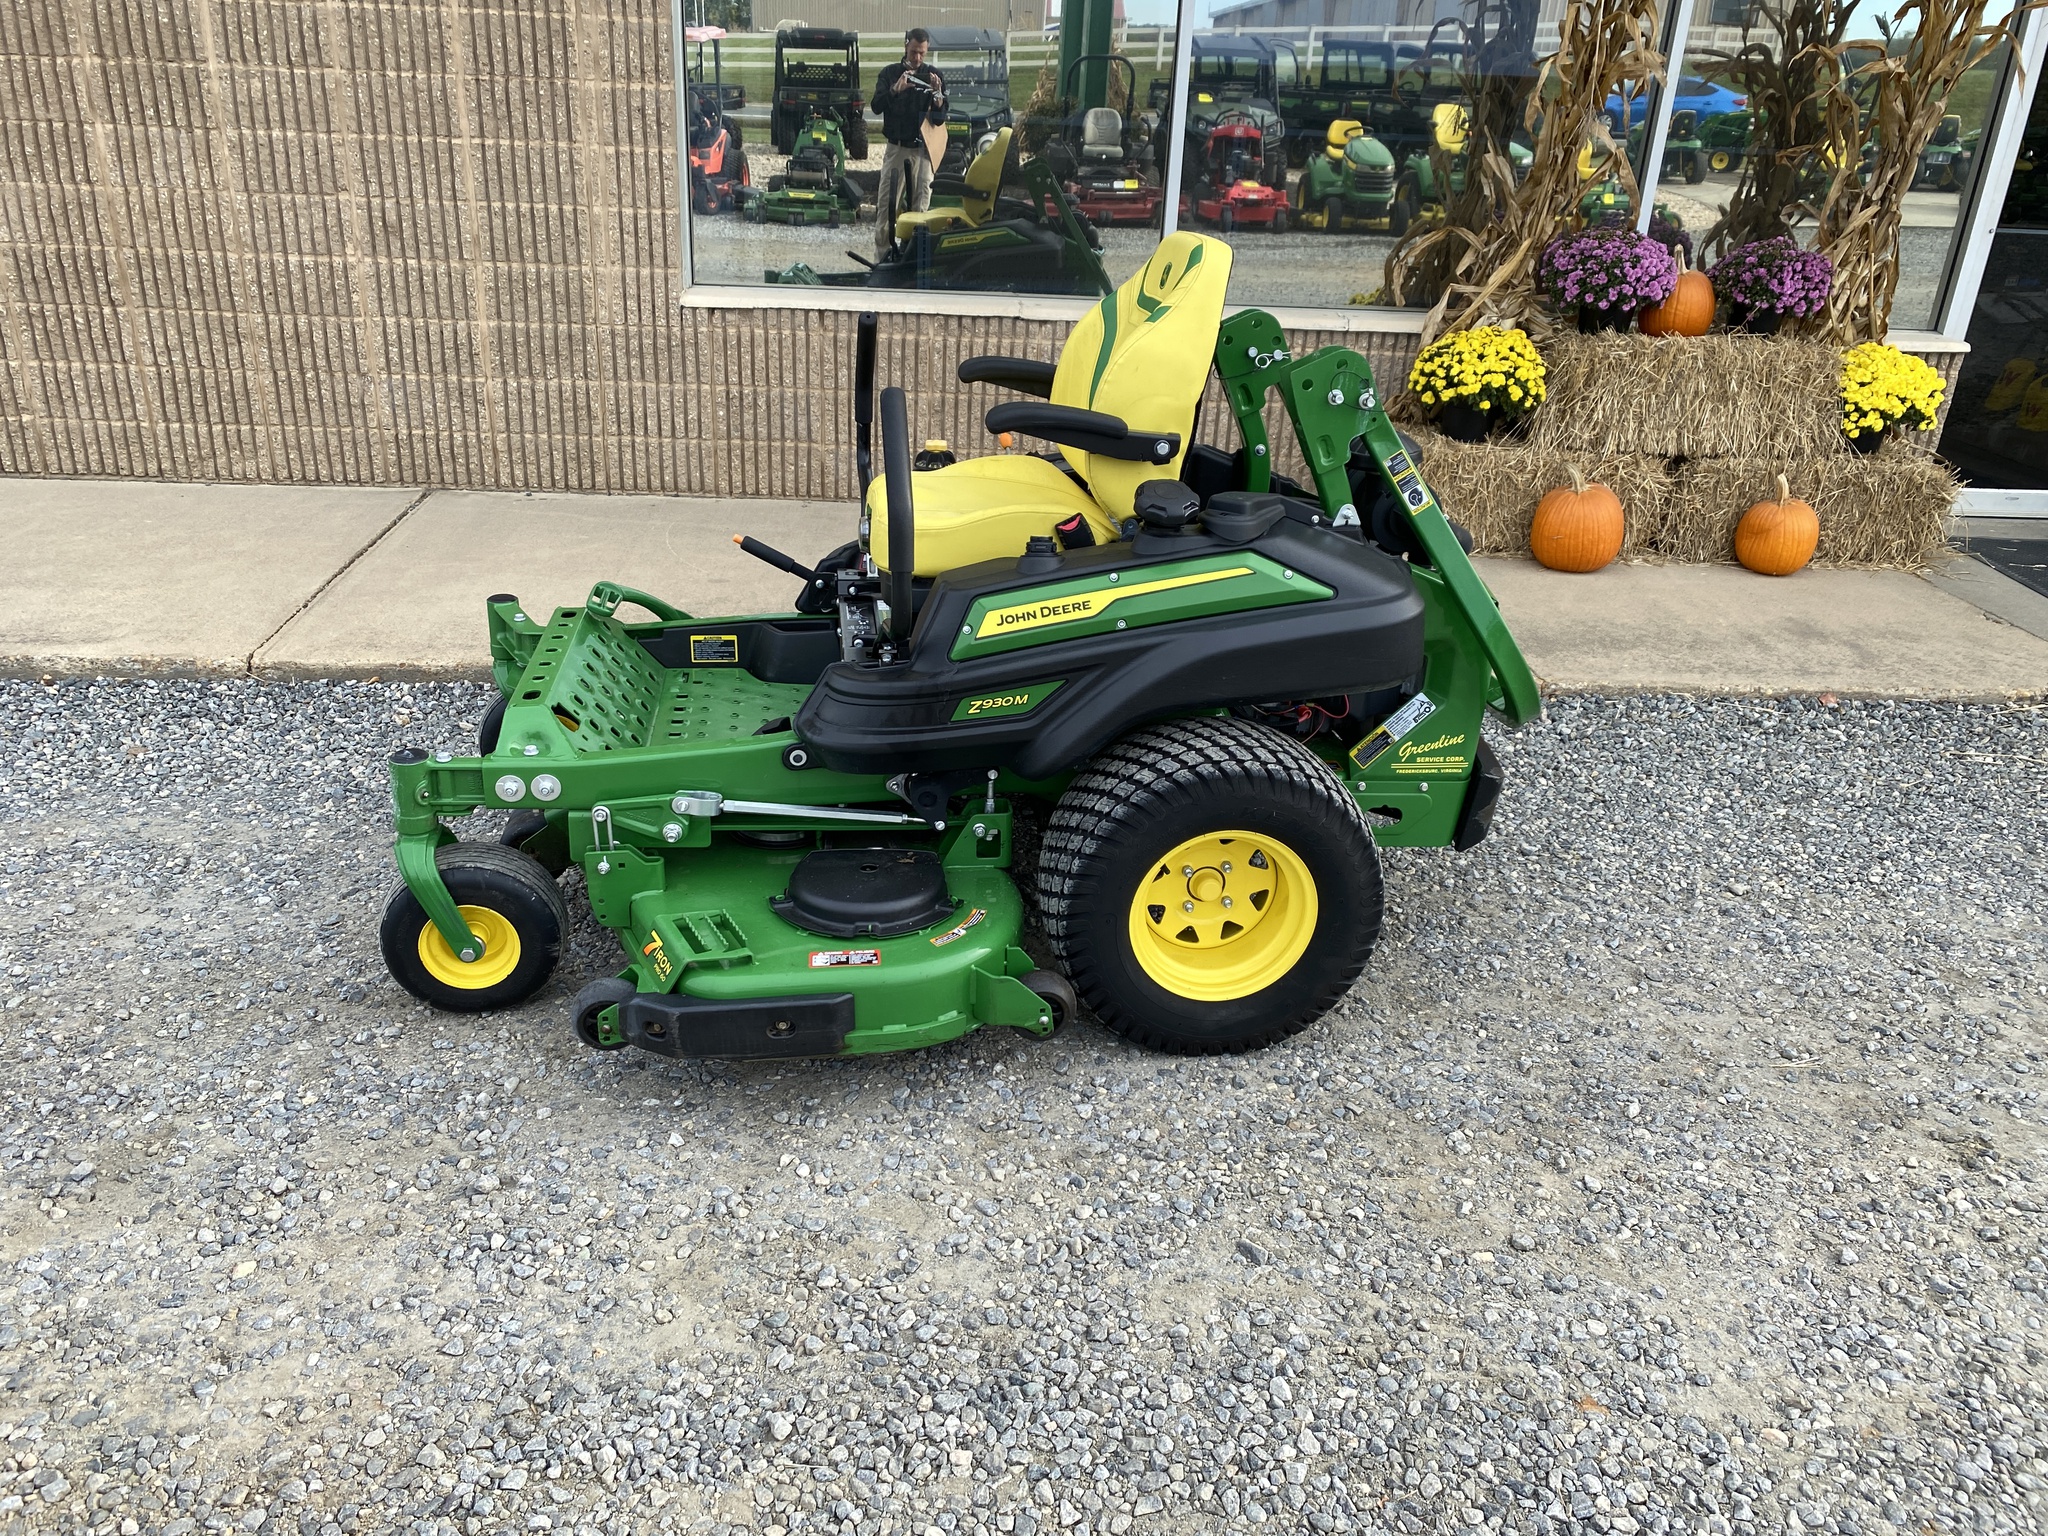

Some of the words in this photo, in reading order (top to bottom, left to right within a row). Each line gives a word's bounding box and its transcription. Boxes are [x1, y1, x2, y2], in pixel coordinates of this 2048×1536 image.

[996, 610, 1037, 627] JOHN
[1040, 600, 1092, 618] DEERE
[967, 694, 1029, 714] Z930M
[1398, 734, 1465, 762] Greenline
